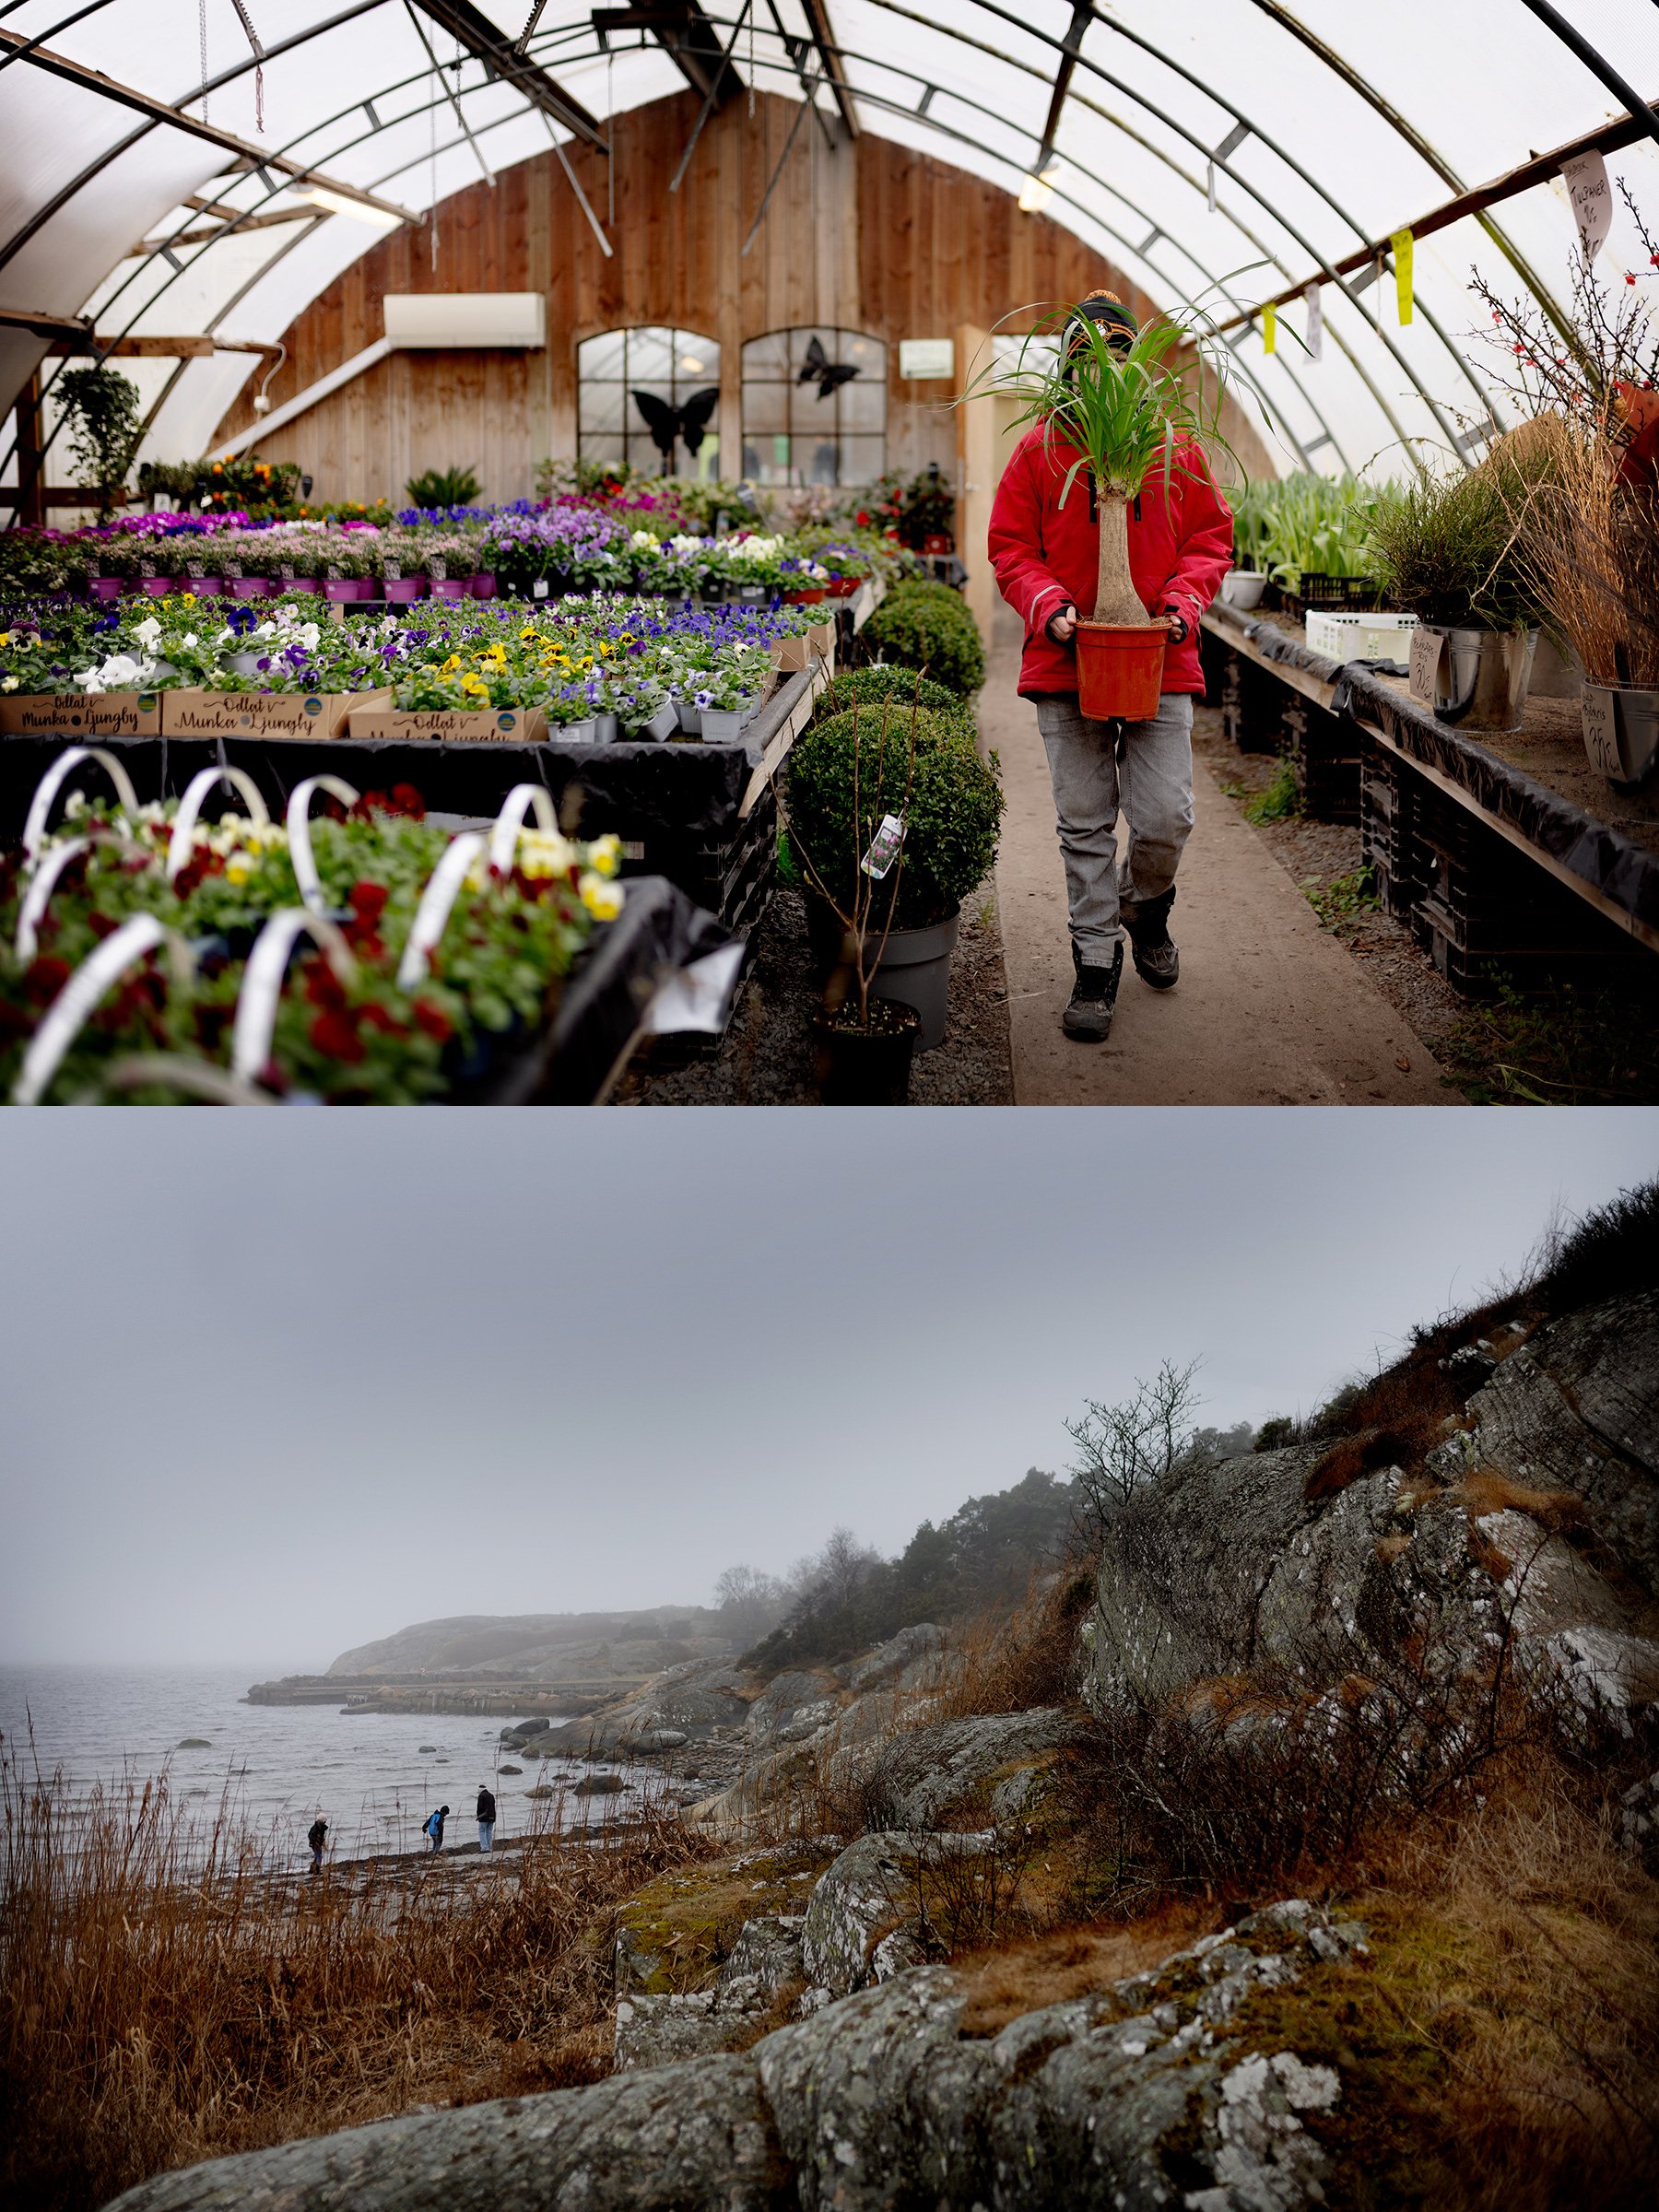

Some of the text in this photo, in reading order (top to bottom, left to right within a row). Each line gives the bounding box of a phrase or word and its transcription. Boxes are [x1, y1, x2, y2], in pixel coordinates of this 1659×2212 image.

[33, 695, 87, 709] Odlat
[203, 697, 265, 713] Odlat
[22, 706, 138, 735] Munka Ljungby
[174, 712, 316, 735] Munka Ljungby
[393, 714, 456, 730] Odlat
